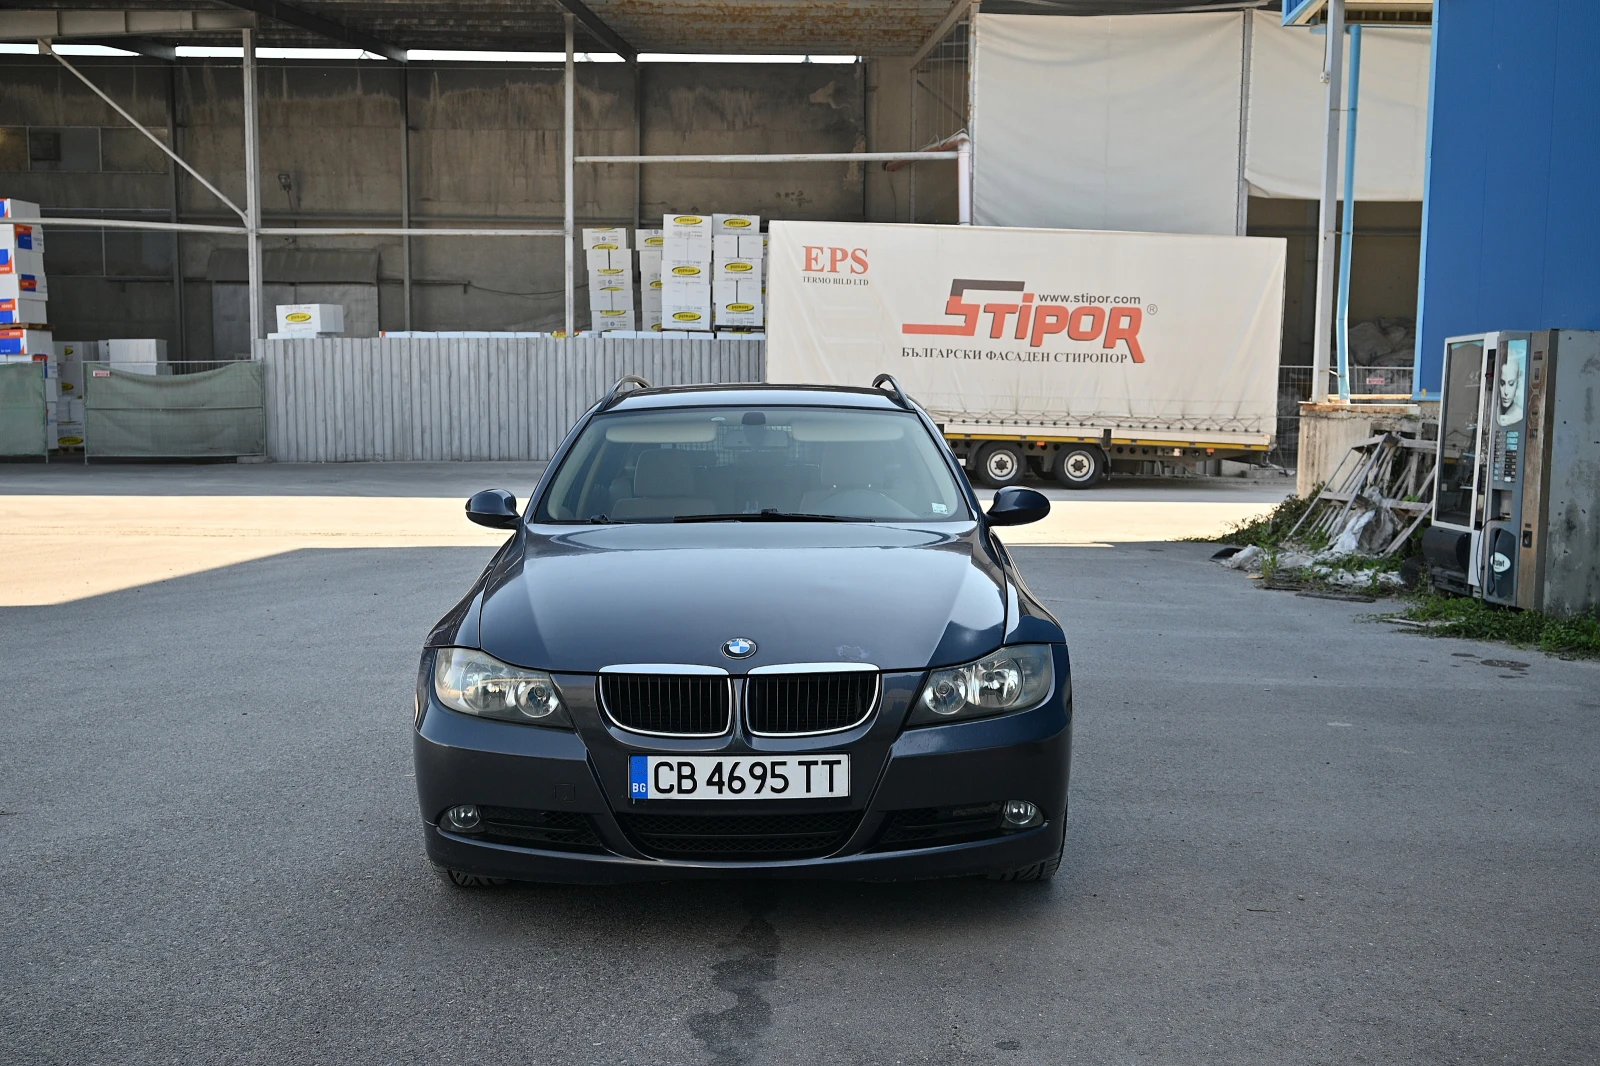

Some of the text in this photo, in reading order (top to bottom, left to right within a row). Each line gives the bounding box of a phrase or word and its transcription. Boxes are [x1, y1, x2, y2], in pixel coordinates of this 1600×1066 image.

[802, 245, 869, 275] EPS
[802, 276, 869, 286] TERMO BILD LTD
[1038, 293, 1141, 306] www.stipor.com
[901, 346, 1128, 364] БЪЛГАРСКИ ФАСАДЕН СТИРОПОР
[653, 759, 842, 795] CB 4695 TT
[632, 782, 646, 793] BG
